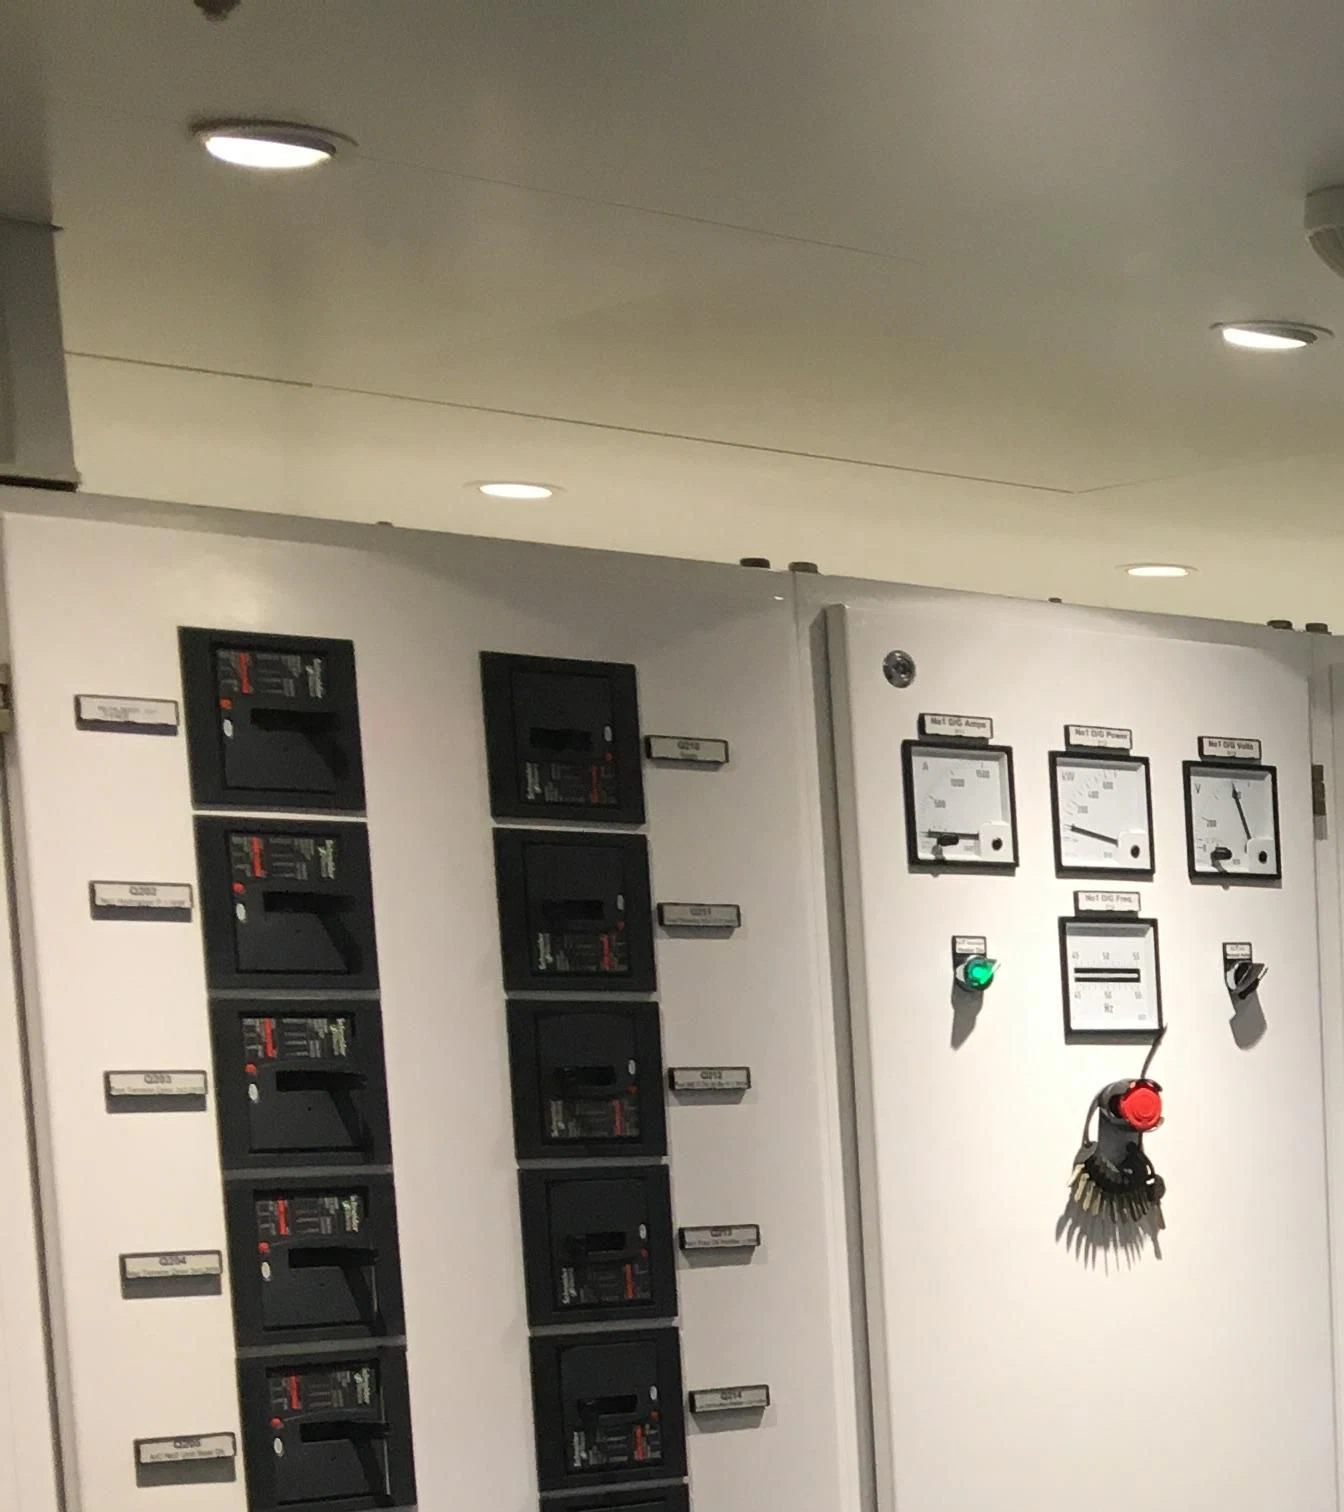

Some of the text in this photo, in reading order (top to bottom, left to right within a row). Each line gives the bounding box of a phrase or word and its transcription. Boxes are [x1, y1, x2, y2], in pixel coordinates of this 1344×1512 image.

[1074, 728, 1128, 740] No1 D/G Power
[1208, 740, 1222, 749] No1
